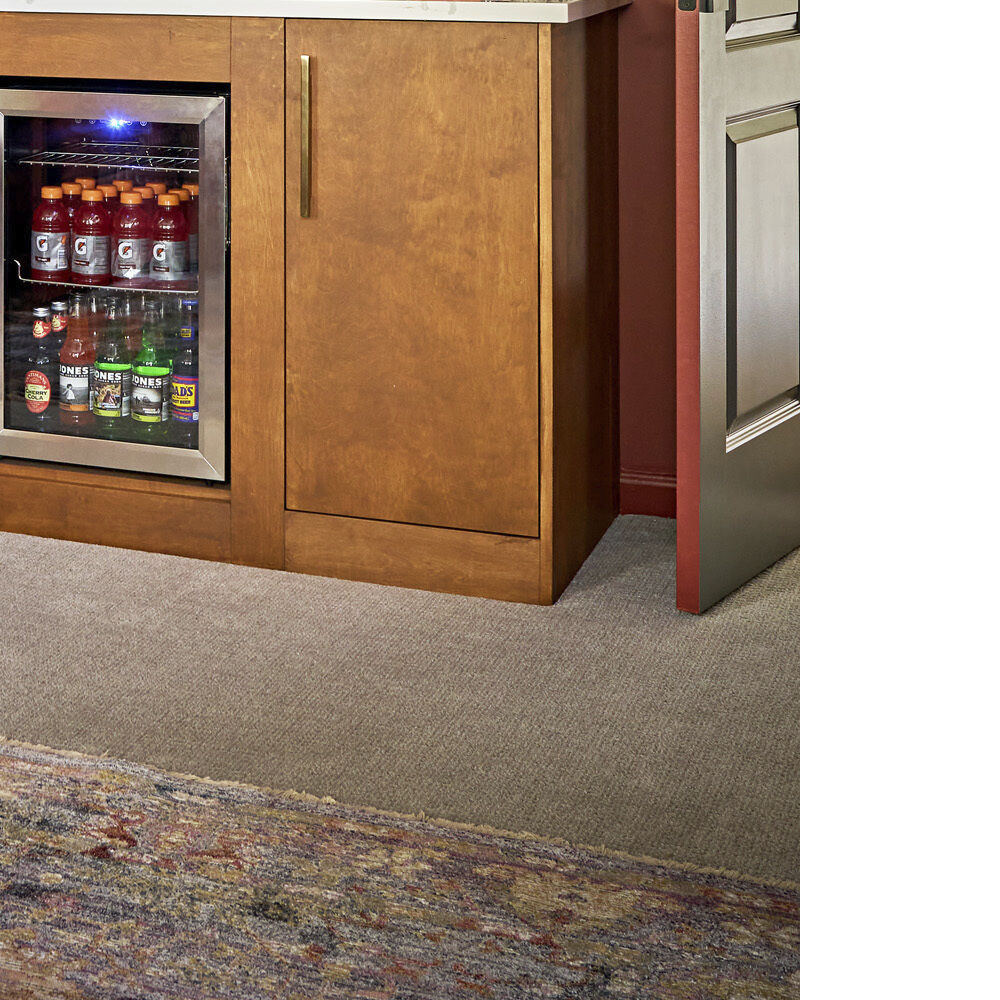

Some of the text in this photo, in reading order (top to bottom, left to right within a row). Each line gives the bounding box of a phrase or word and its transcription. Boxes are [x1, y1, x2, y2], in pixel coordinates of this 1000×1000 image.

[36, 236, 48, 251] G
[75, 238, 86, 254] G
[118, 242, 133, 259] G
[153, 244, 166, 260] G
